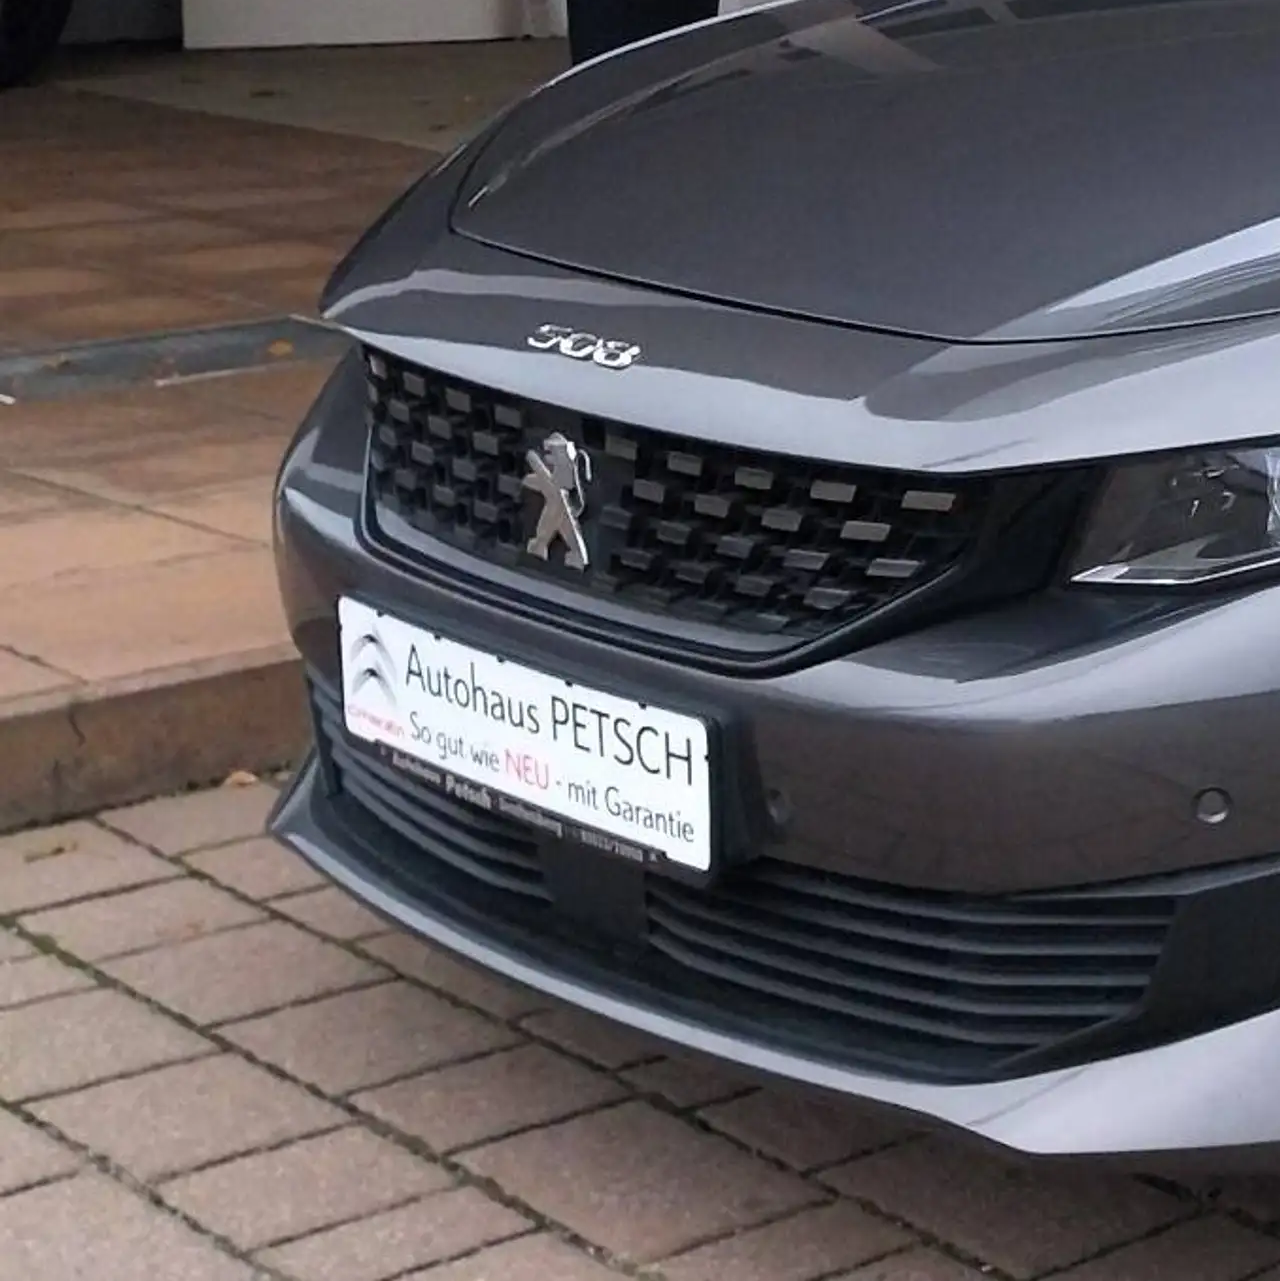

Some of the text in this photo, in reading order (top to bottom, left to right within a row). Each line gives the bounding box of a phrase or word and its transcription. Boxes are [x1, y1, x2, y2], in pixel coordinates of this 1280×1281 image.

[527, 323, 642, 367] 508
[405, 643, 540, 735] Autohaus
[551, 695, 694, 786] PETSCH
[409, 710, 432, 746] So
[436, 730, 466, 760] gut
[470, 741, 501, 772] wie
[504, 748, 550, 790] NEU
[567, 778, 599, 811] mit
[604, 785, 695, 843] Garantie
